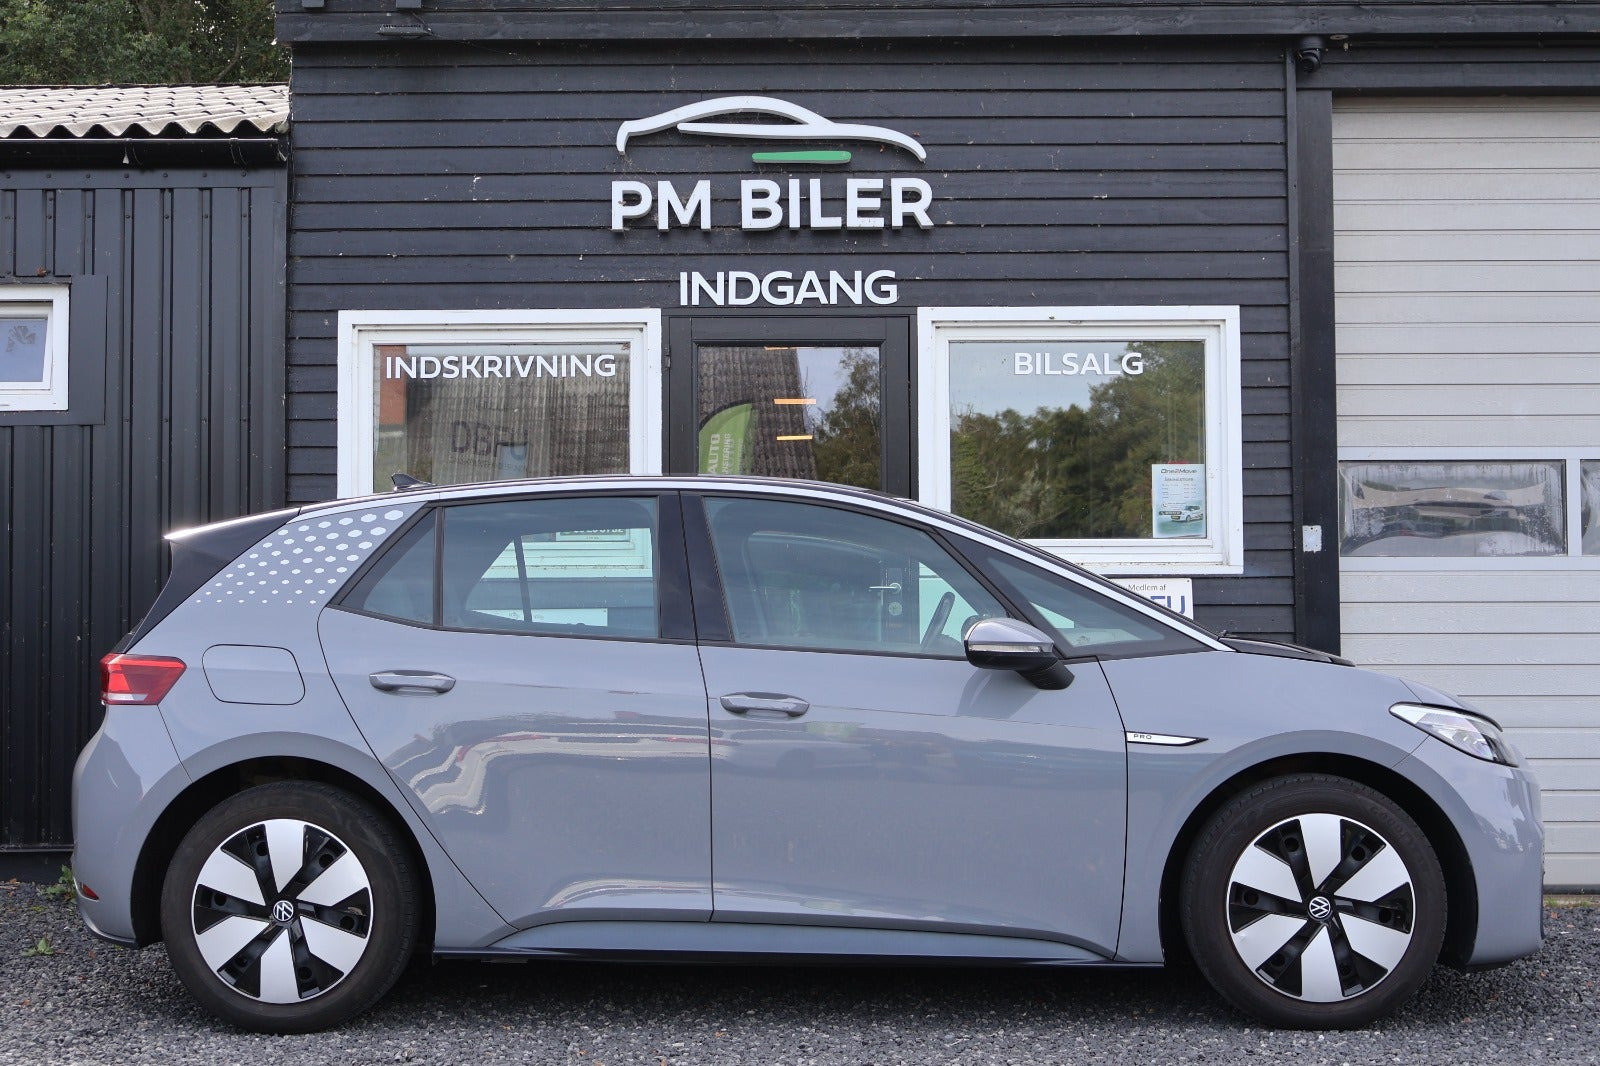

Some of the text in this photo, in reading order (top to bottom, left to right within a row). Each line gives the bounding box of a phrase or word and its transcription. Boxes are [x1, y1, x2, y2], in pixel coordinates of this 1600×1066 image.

[611, 178, 934, 232] PM BILER
[679, 270, 898, 305] INDGANG
[386, 354, 616, 379] INDSKRIVNING
[1014, 352, 1144, 375] BILSALG
[708, 434, 720, 474] AUTO
